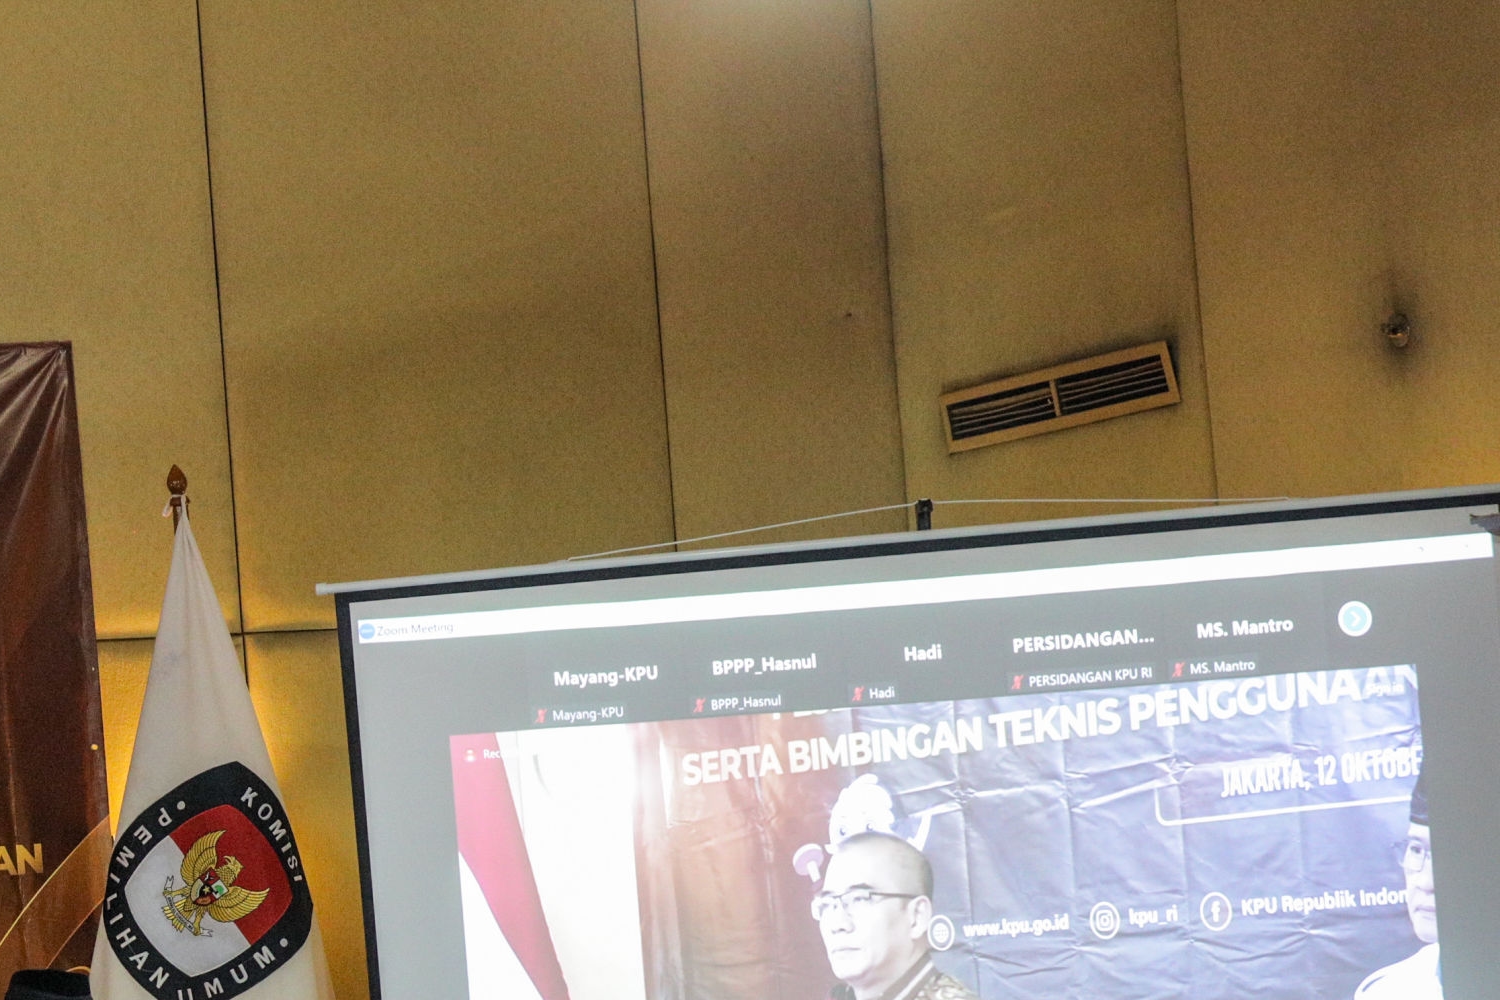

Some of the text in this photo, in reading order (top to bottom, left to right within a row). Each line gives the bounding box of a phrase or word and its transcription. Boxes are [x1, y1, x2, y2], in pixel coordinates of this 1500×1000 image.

[1196, 617, 1294, 640] MS. Mantro
[904, 643, 943, 662] Hadi
[712, 653, 817, 676] BPPP_Hasnul
[1213, 659, 1256, 674] Mantro
[553, 665, 659, 689] Mayang-KPU
[1028, 667, 1153, 688] PERSIDANGAN KPU RI
[711, 695, 782, 711] BPPP_Hasnul
[869, 686, 895, 699] Hadi
[552, 706, 624, 723] Mayang-KPU
[681, 744, 784, 787] SERTA
[787, 716, 984, 773] BIMBINGAN
[988, 698, 1122, 748] TEKNIS
[1221, 759, 1312, 798] JAKARTA,
[1314, 754, 1337, 786] 12
[241, 787, 303, 882] KOMISI
[104, 807, 173, 989] PEMILIHAN
[1241, 897, 1277, 916] KPU
[1281, 893, 1355, 914] Republik
[963, 912, 1070, 938] www.kpu.go.id
